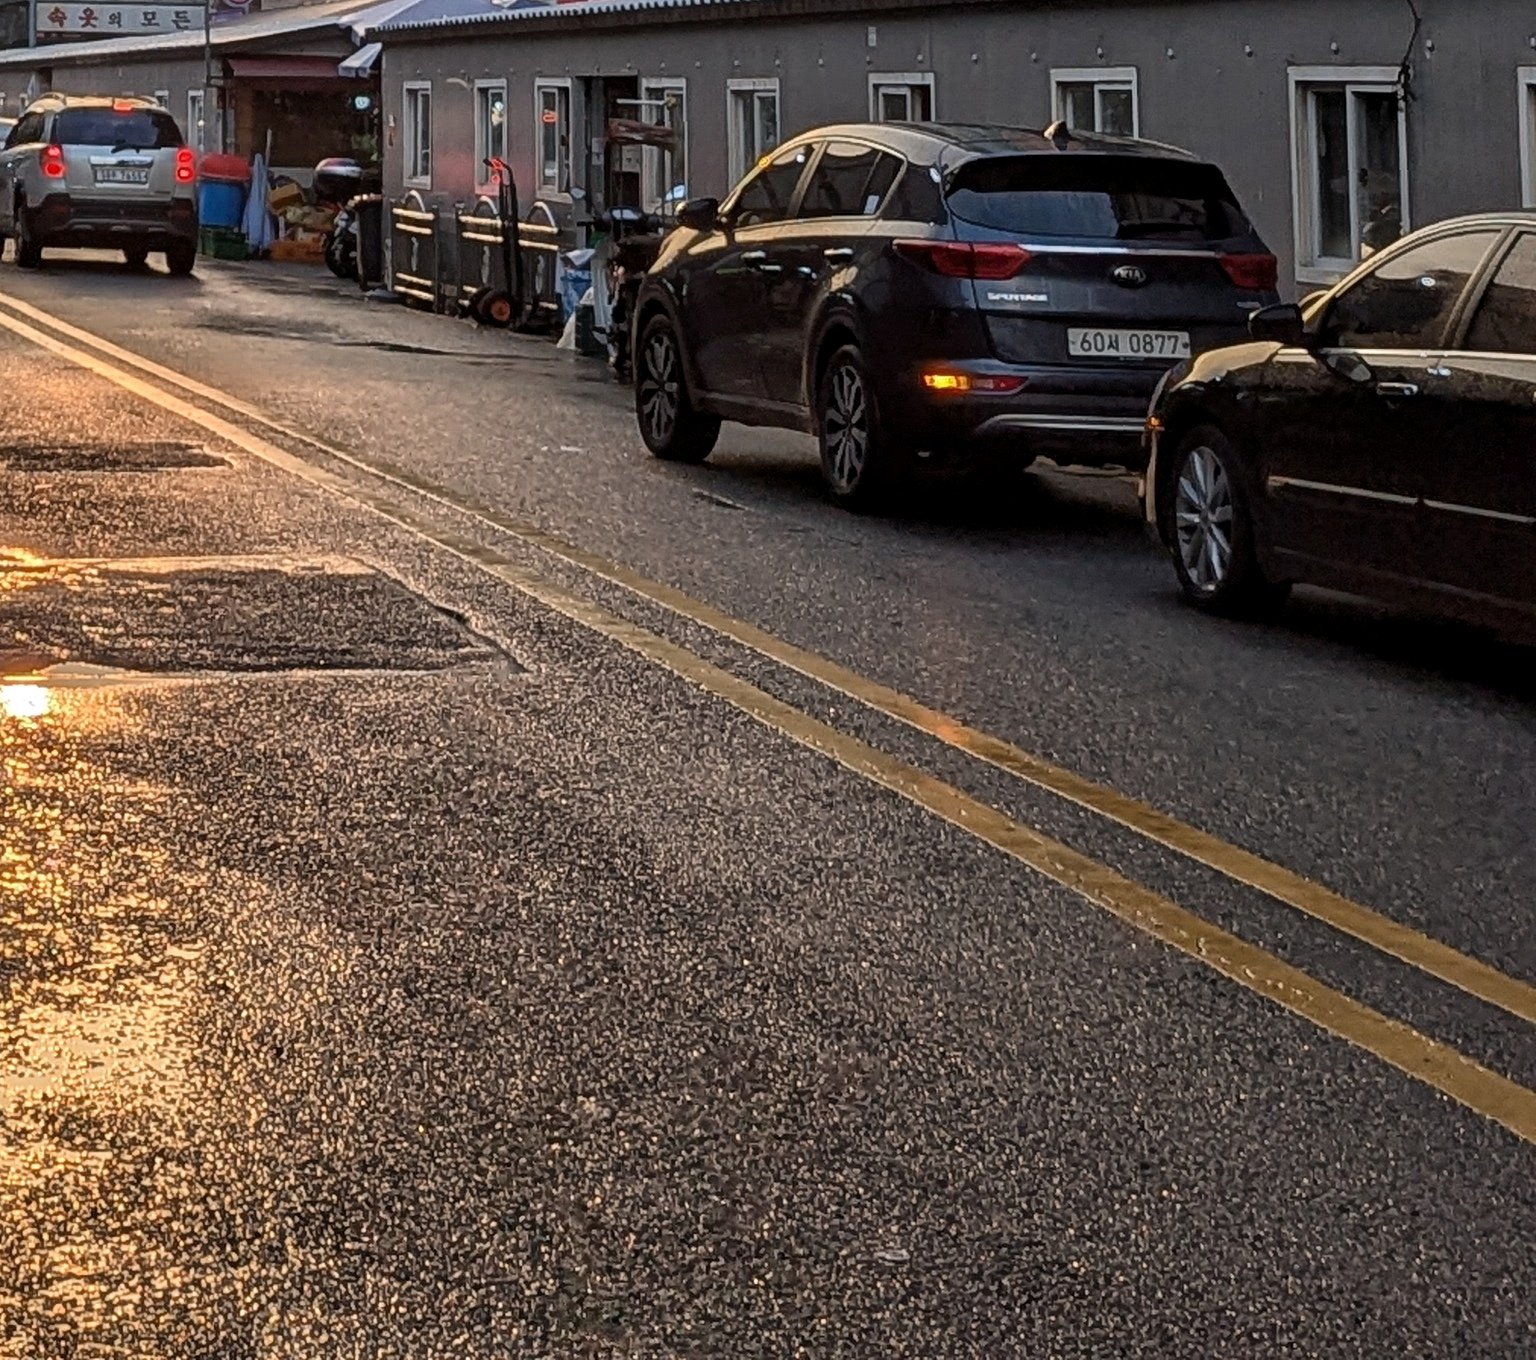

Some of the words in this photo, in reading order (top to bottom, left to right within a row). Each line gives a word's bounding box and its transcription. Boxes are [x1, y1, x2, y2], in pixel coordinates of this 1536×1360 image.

[47, 6, 122, 28] 속옷의
[140, 10, 191, 30] 모든
[1129, 333, 1179, 355] 0877
